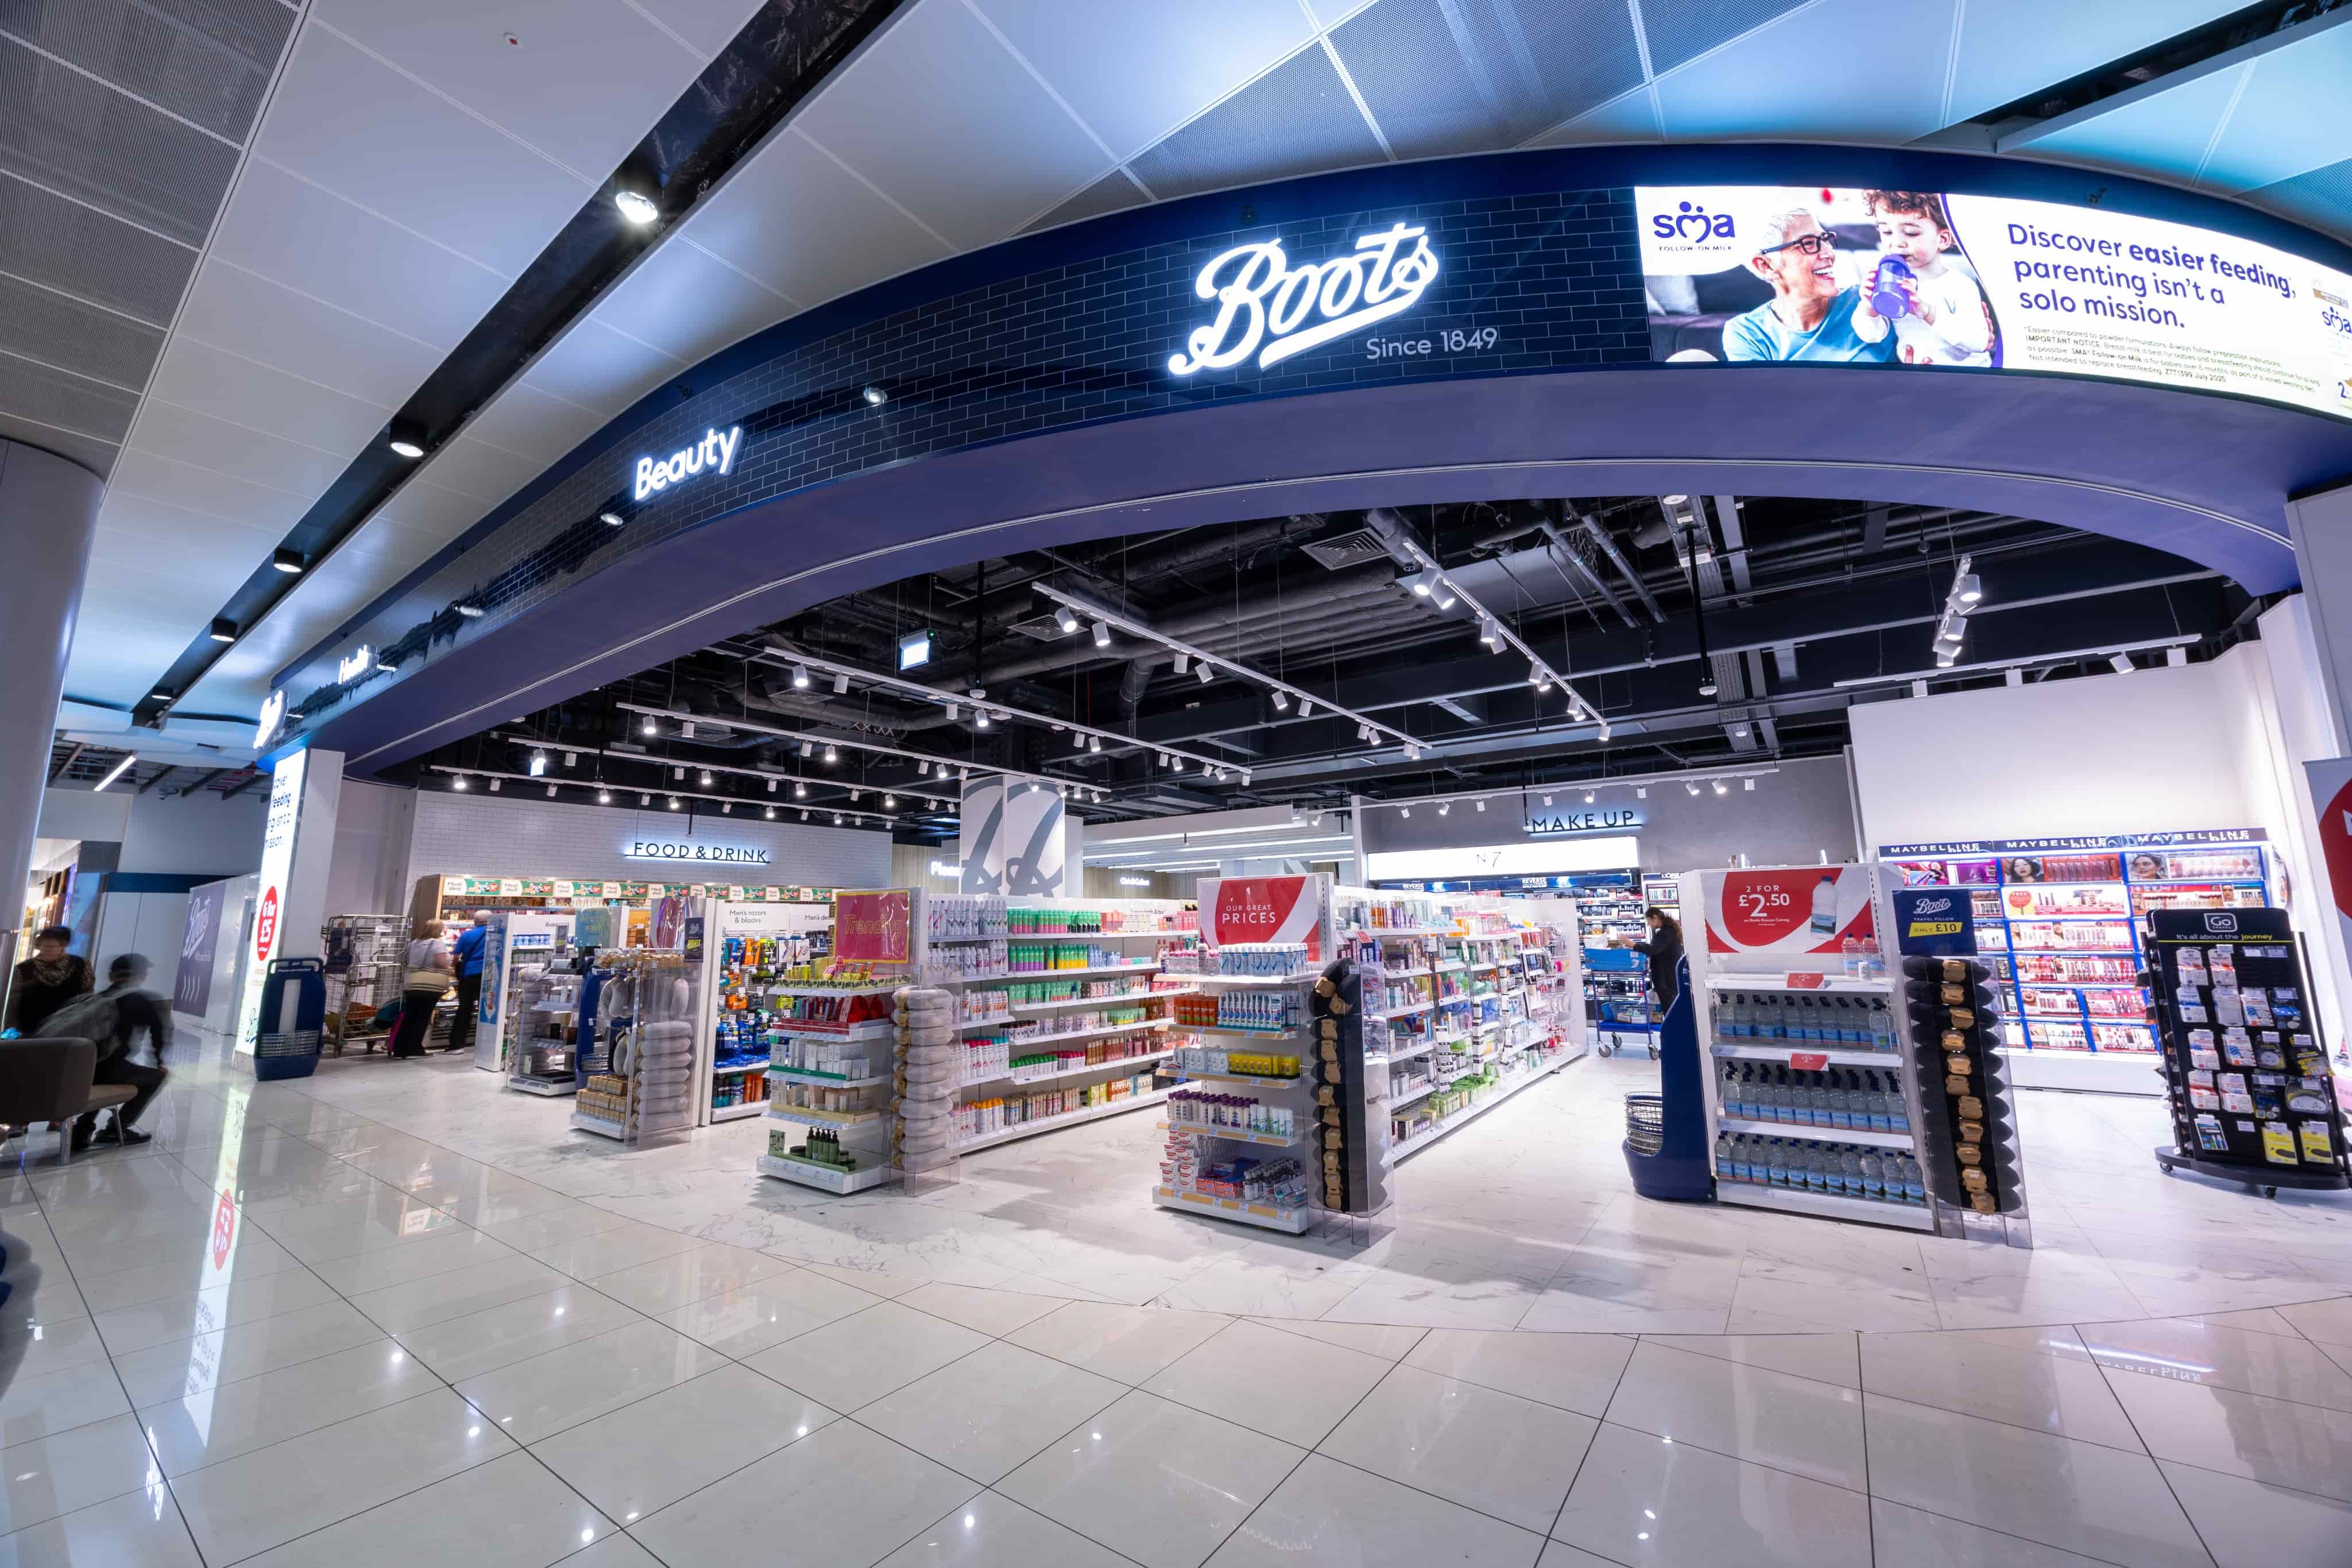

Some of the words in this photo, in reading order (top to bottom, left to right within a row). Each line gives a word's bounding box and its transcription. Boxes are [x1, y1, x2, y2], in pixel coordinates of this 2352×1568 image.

[2007, 224, 2122, 257] Discover
[2129, 244, 2204, 271] easier
[2210, 254, 2296, 299] feeding,
[2014, 261, 2147, 297] parenting
[2152, 273, 2204, 300] isn't
[2211, 288, 2225, 304] a
[1168, 222, 1438, 373] Boots
[2020, 289, 2076, 313] solo
[2084, 296, 2185, 328] mission.
[1367, 337, 1432, 360] Since
[1440, 327, 1498, 353] 1849
[2026, 335, 2071, 344] IMPORTANT
[635, 427, 741, 500] Beauty
[1532, 814, 1596, 832] MAKE
[1604, 810, 1634, 826] UP
[635, 842, 690, 858] FOOD
[696, 846, 707, 859] &
[713, 847, 767, 862] DRINK
[1891, 843, 1980, 853] MAYBELLINE
[1739, 893, 1790, 917] £2.50
[1914, 899, 1951, 914] Boots
[844, 913, 902, 940] Trendg
[1223, 912, 1276, 924] PRICES
[1936, 924, 1956, 932] £10
[2211, 917, 2231, 926] Go
[260, 919, 272, 943] £5
